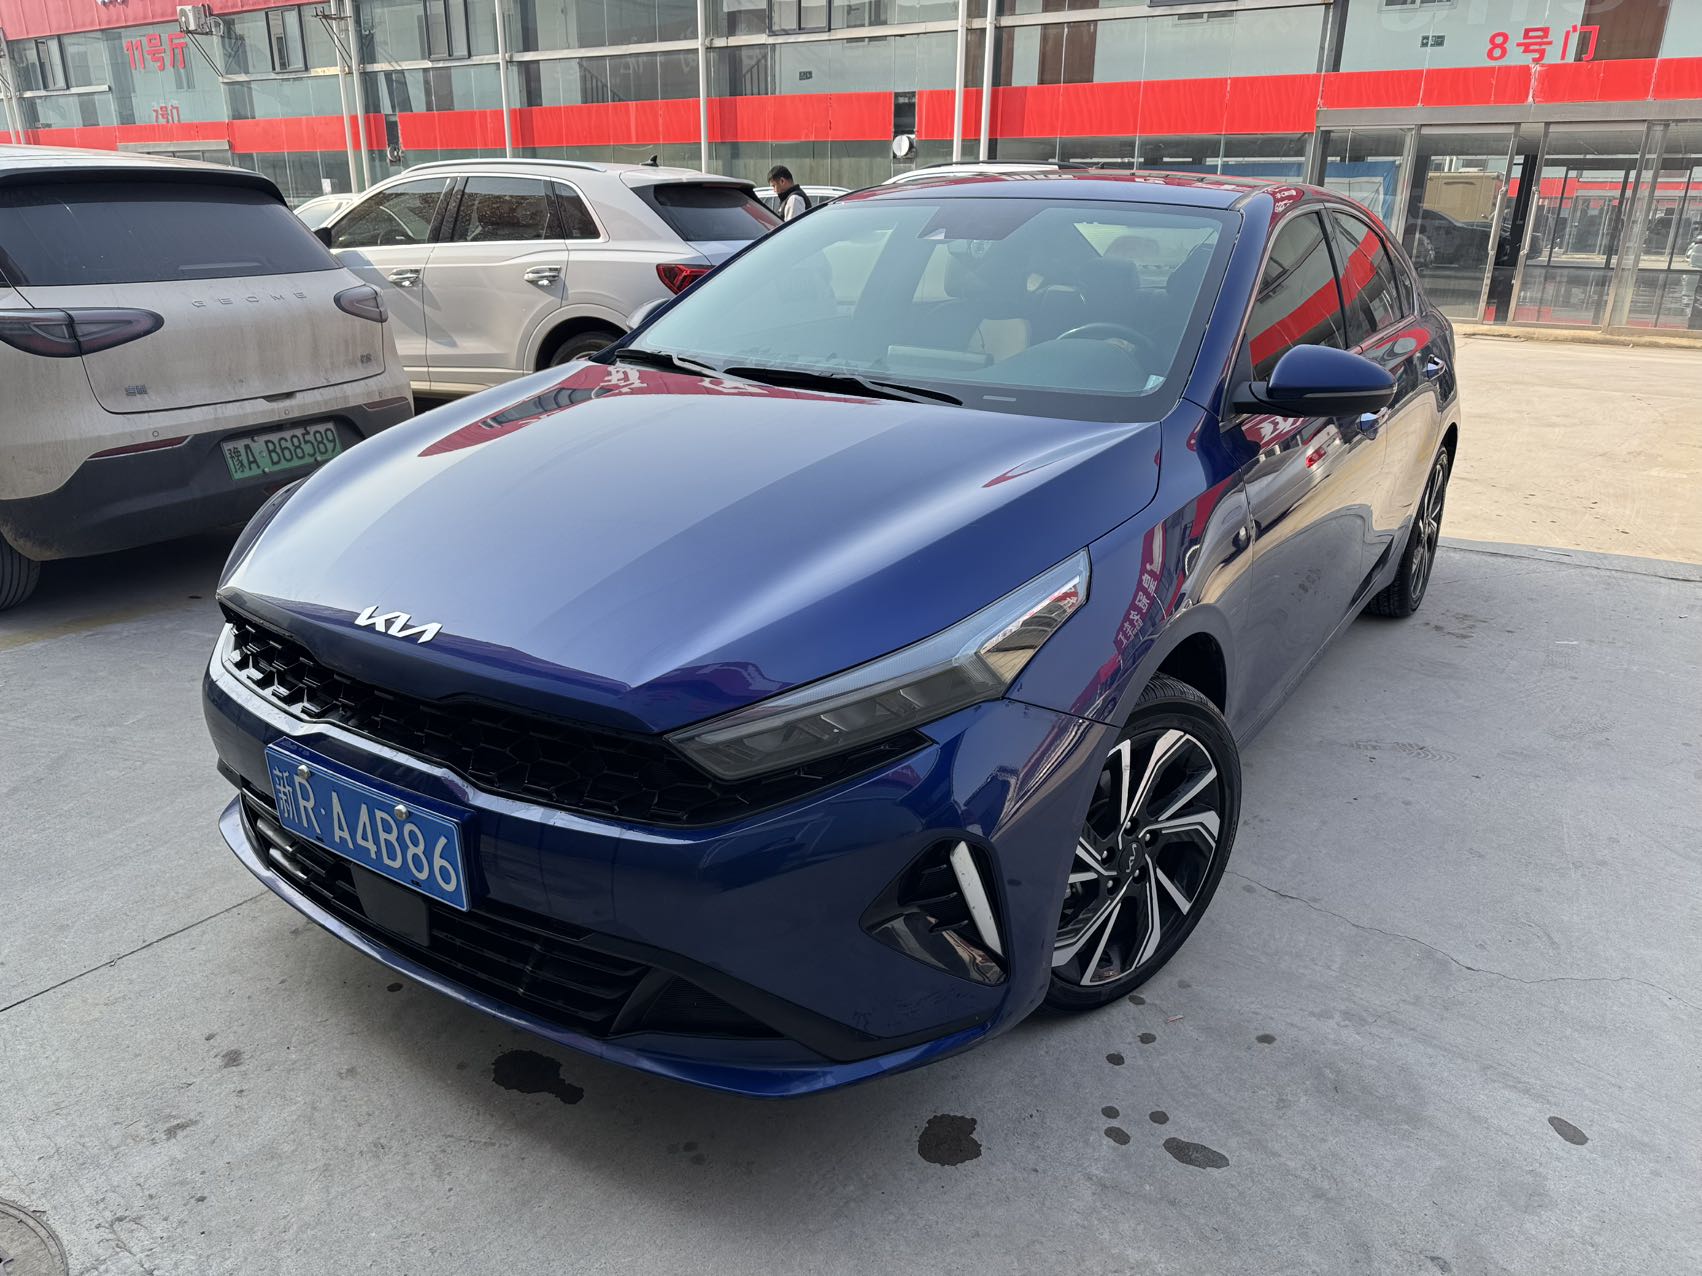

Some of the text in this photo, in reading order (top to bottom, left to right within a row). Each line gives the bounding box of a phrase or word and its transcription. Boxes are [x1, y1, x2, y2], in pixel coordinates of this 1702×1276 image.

[124, 32, 188, 71] 11号厅
[1486, 24, 1600, 63] 8号门
[354, 605, 444, 644] KIA
